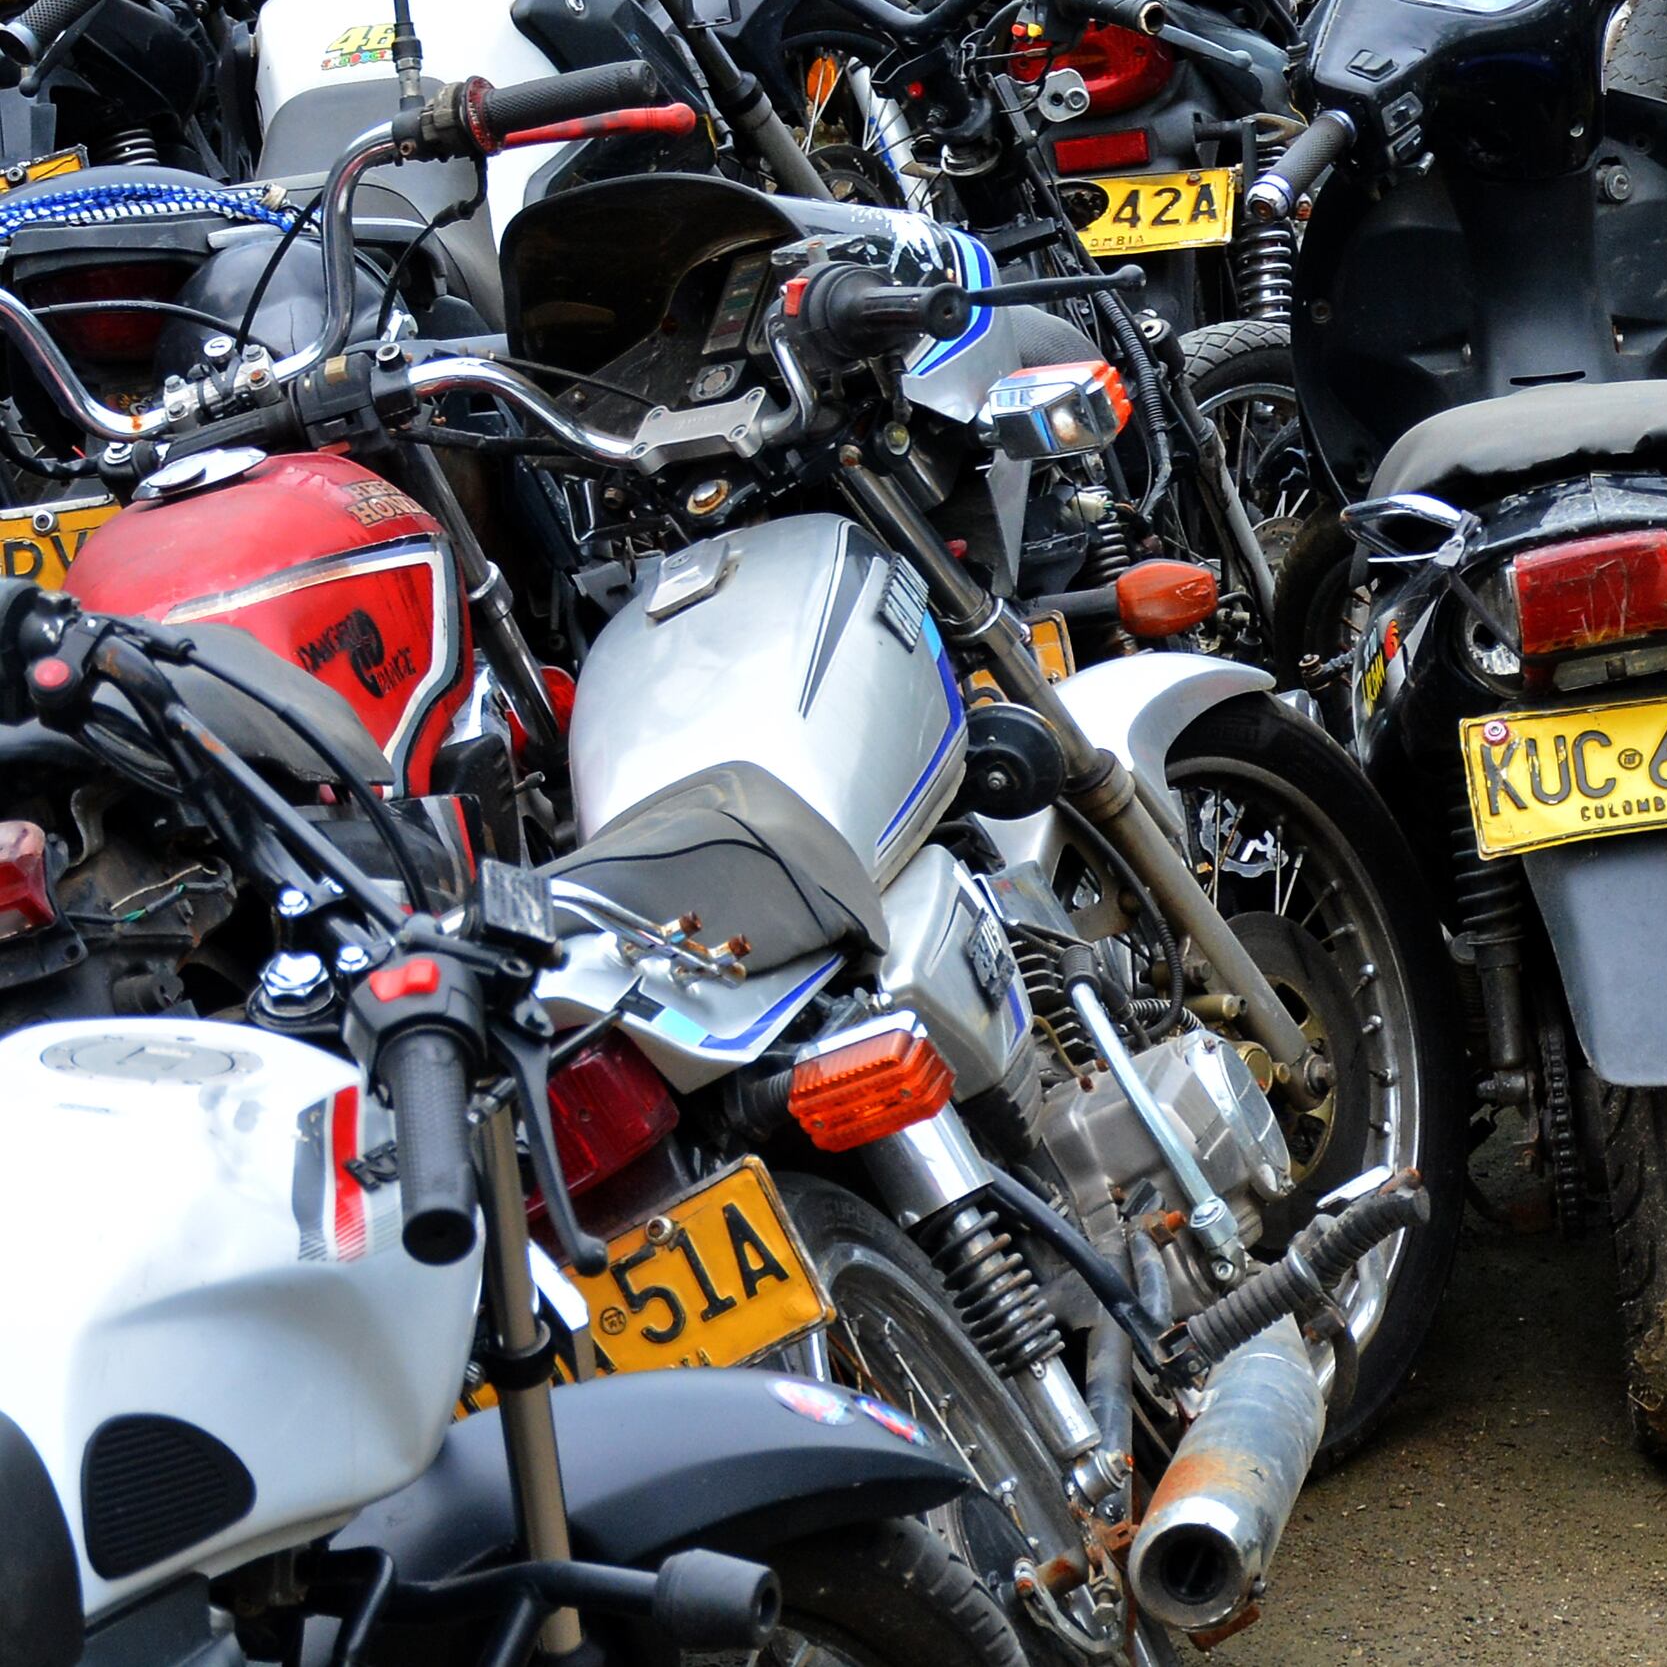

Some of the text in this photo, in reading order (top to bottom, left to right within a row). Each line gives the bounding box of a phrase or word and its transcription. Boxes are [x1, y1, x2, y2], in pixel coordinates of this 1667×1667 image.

[1112, 183, 1218, 229] 42A
[1480, 728, 1617, 817] KUC
[610, 1201, 791, 1344] 51A
